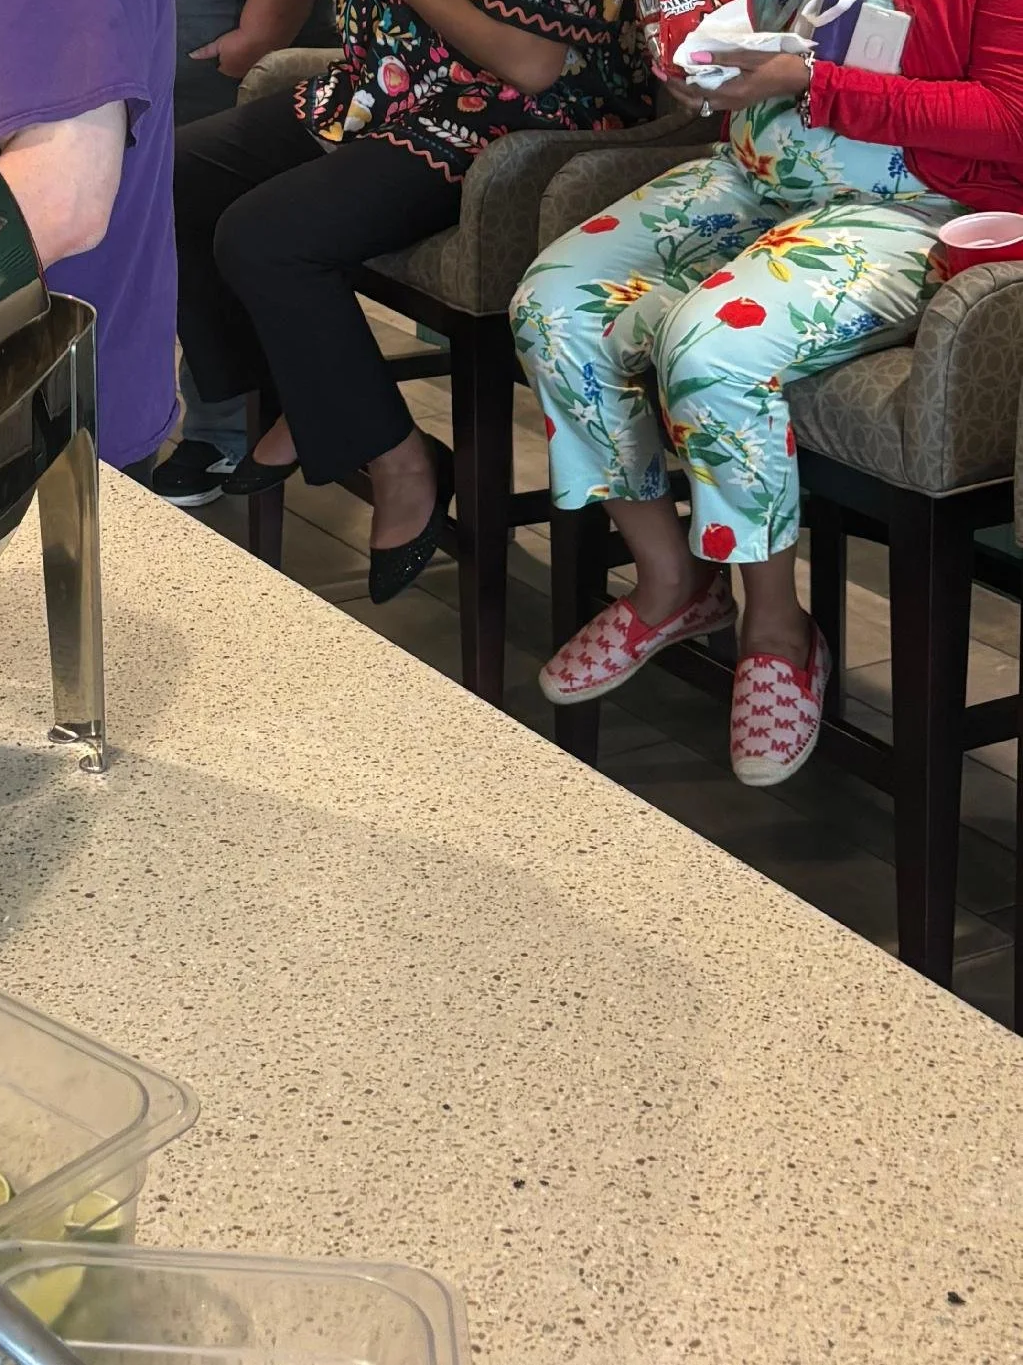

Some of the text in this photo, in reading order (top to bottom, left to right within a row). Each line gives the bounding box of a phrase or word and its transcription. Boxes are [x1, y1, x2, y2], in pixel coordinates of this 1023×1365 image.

[752, 681, 775, 693] MK
[776, 695, 798, 709] MK
[751, 705, 773, 717] MK
[774, 718, 796, 732] MK
[748, 727, 771, 739] MK
[771, 739, 793, 755] MK
